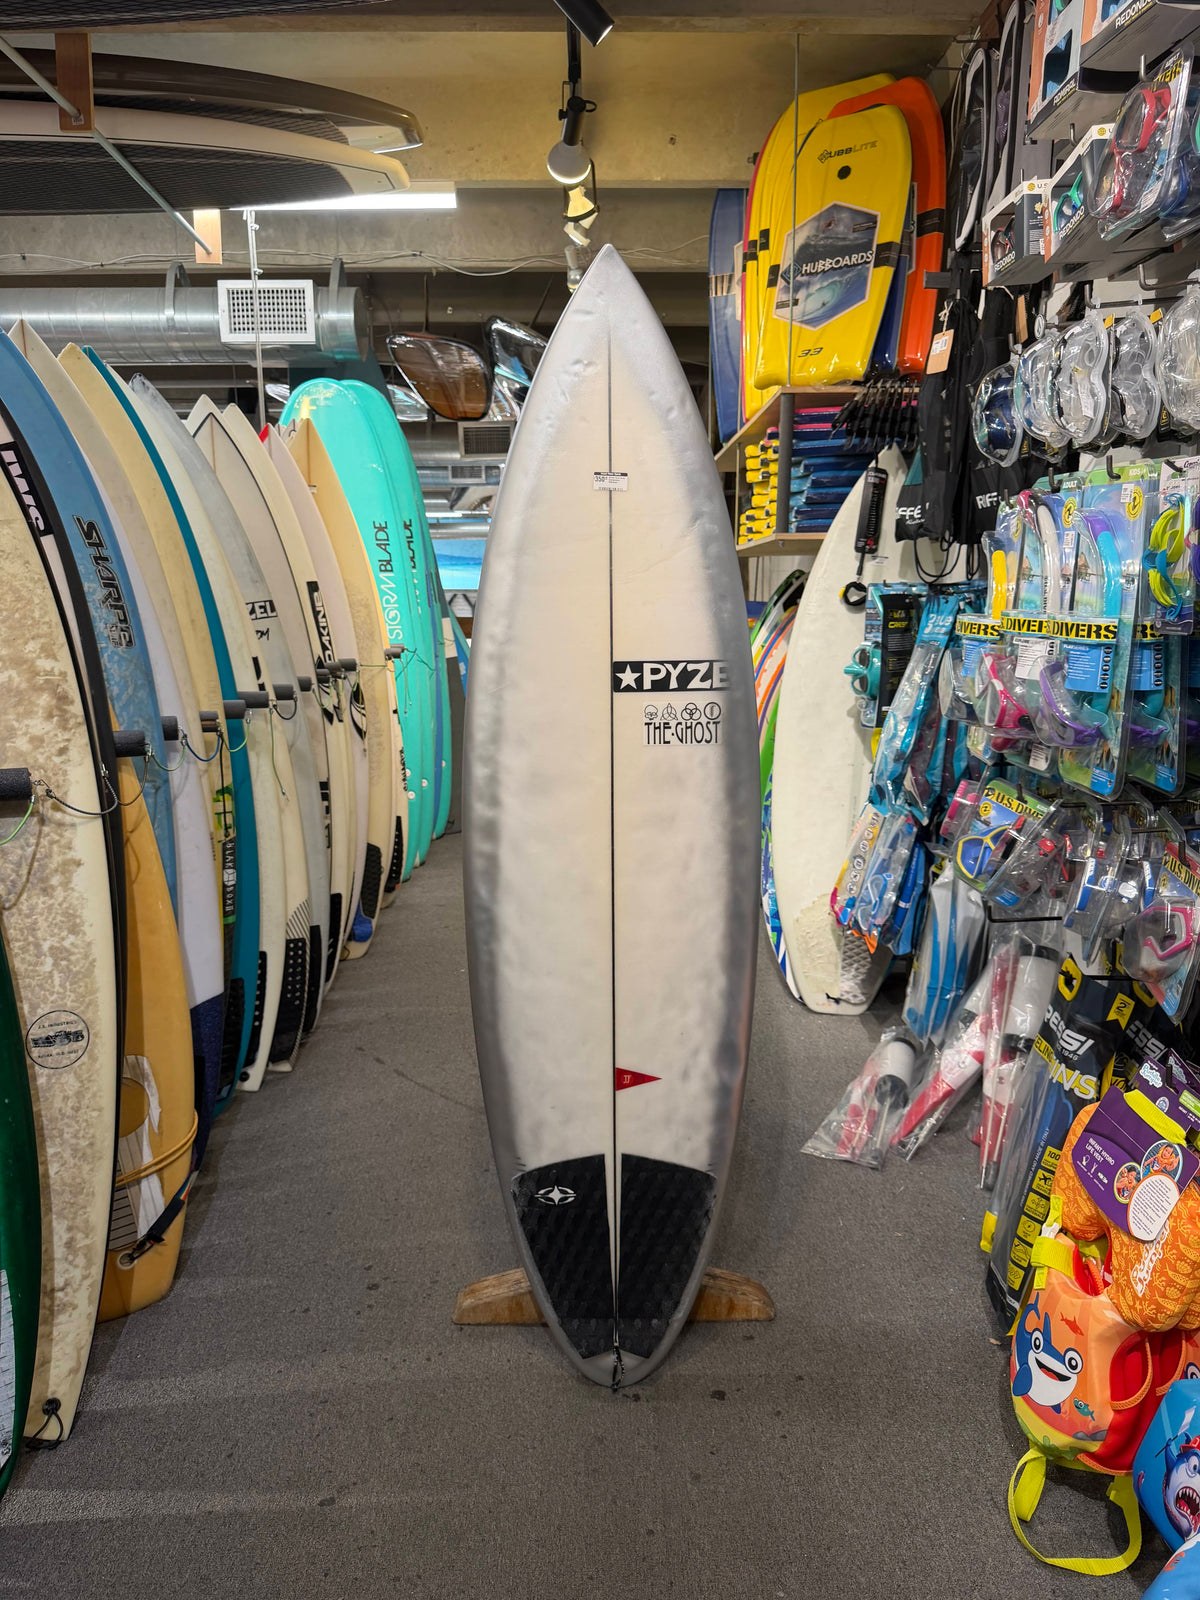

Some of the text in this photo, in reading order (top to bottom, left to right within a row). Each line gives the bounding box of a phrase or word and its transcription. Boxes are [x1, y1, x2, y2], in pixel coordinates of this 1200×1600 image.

[1059, 206, 1085, 239] REDONDO
[801, 250, 873, 275] HUBBOARDS
[994, 251, 1015, 272] REDONDO
[798, 347, 823, 358] 33
[372, 520, 402, 640] STORMBLADE
[1053, 620, 1117, 639] DIVERS
[1085, 1144, 1095, 1156] LIFE
